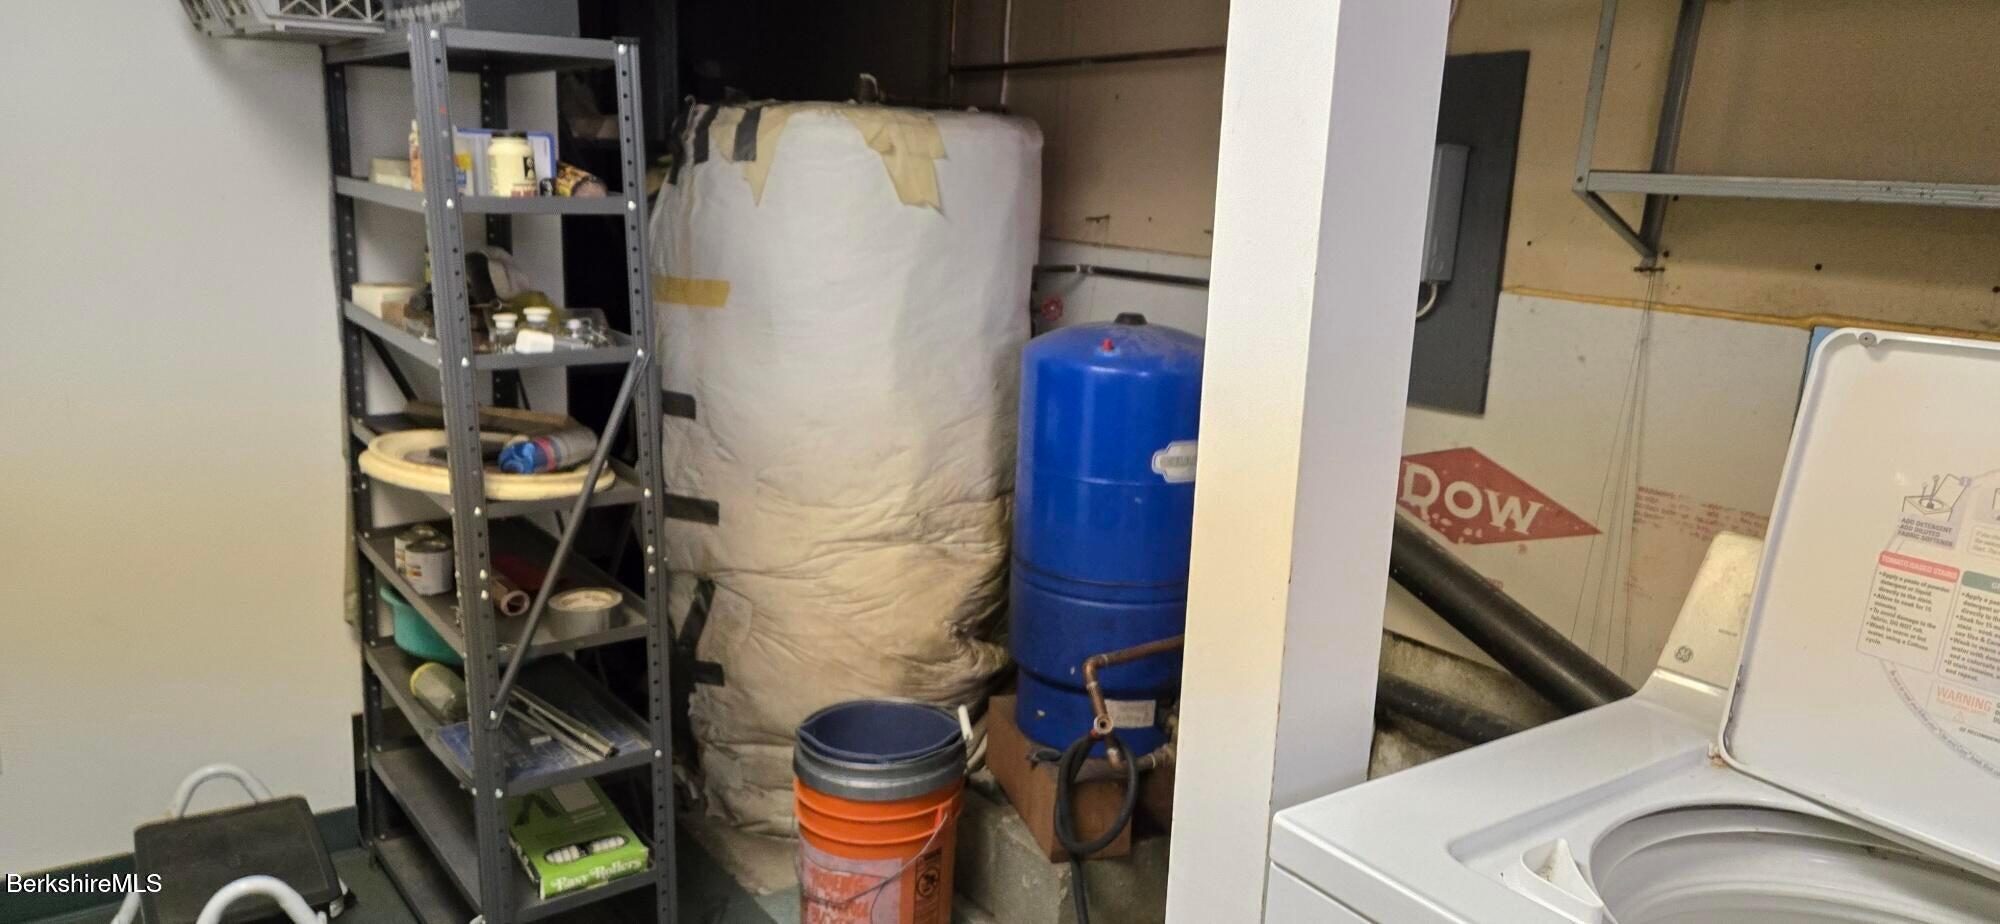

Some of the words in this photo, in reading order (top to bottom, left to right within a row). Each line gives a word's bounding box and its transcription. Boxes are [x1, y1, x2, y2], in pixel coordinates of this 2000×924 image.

[1400, 462, 1544, 535] DOW
[1936, 686, 1993, 712] WARNING
[588, 859, 642, 880] Rollers
